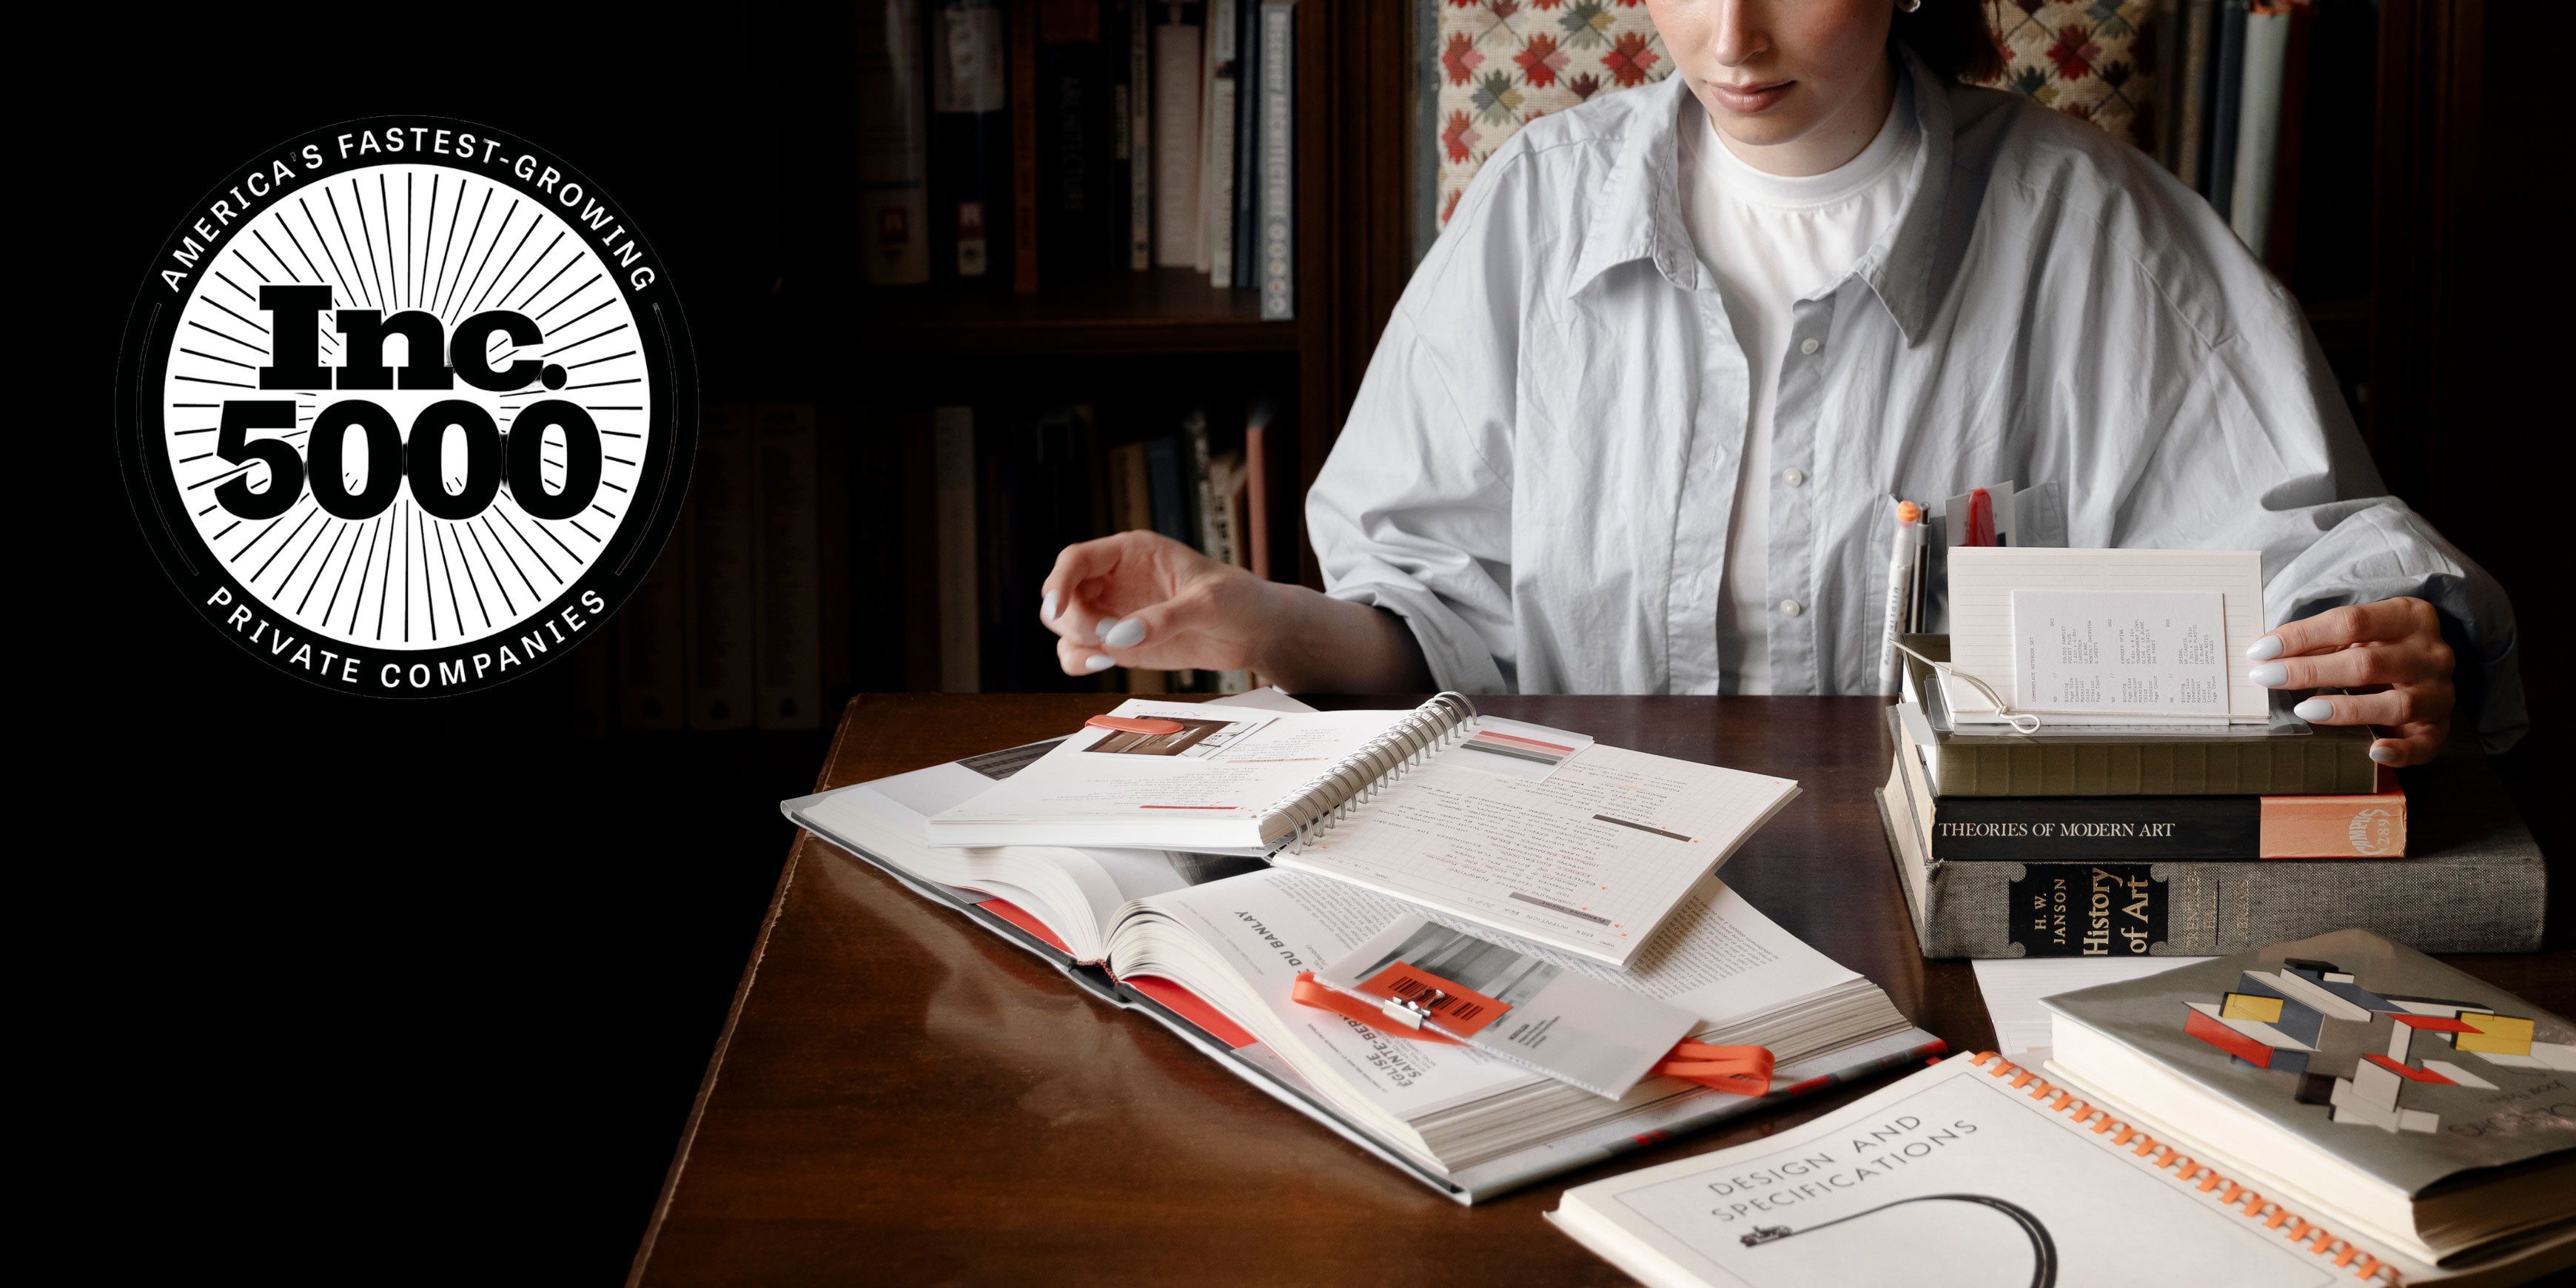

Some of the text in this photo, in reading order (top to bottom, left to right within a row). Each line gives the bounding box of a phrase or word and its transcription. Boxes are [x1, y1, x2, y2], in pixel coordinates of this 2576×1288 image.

[1939, 822, 2176, 837] THEORIES OF MODERN ART
[2349, 808, 2391, 855] CAMPUS
[2378, 819, 2390, 845] 289
[1234, 910, 1286, 949] BANLAY
[2035, 893, 2047, 930] H. W.
[2053, 878, 2066, 945] JANSON
[2083, 867, 2123, 955] History
[2121, 876, 2149, 953] of Art
[1280, 950, 1303, 970] DU
[1338, 1013, 1423, 1079] SAINTE-BERN
[1366, 1054, 1414, 1088] ÉGLISE
[1708, 1115, 1921, 1198] DESIGN AND
[1711, 1118, 1979, 1223] SPECIFICATIONS
